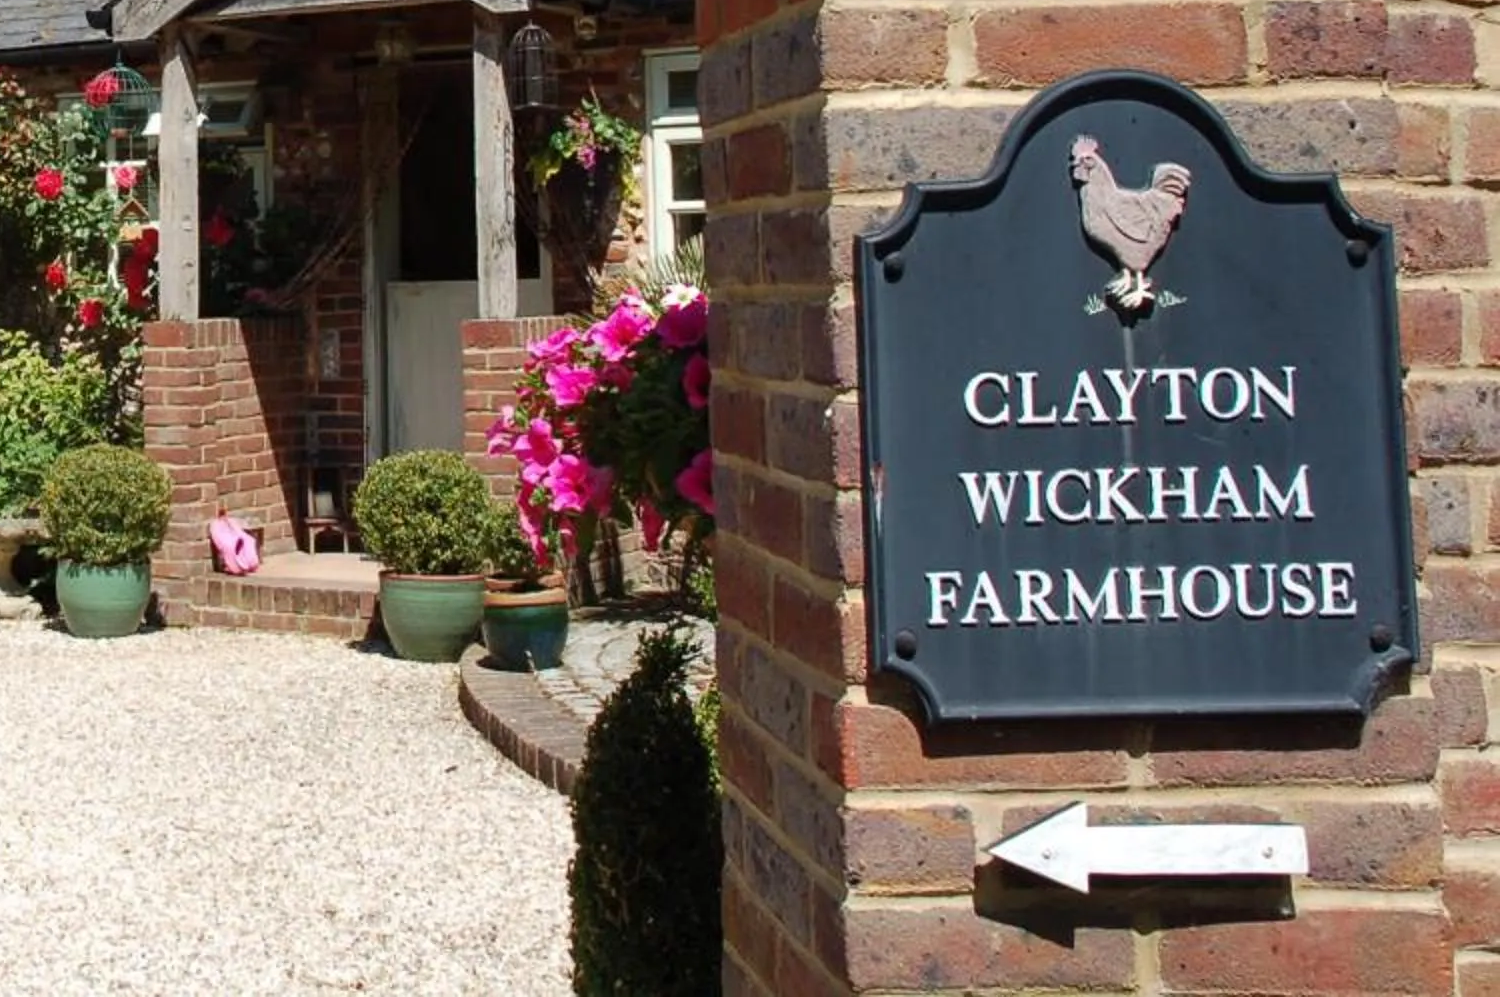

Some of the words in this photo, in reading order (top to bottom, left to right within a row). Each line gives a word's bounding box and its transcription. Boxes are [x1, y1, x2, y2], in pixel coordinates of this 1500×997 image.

[963, 365, 1298, 425] CLAYTON
[958, 463, 1316, 524] WICKHAM
[924, 561, 1359, 625] FARMHOUSE
